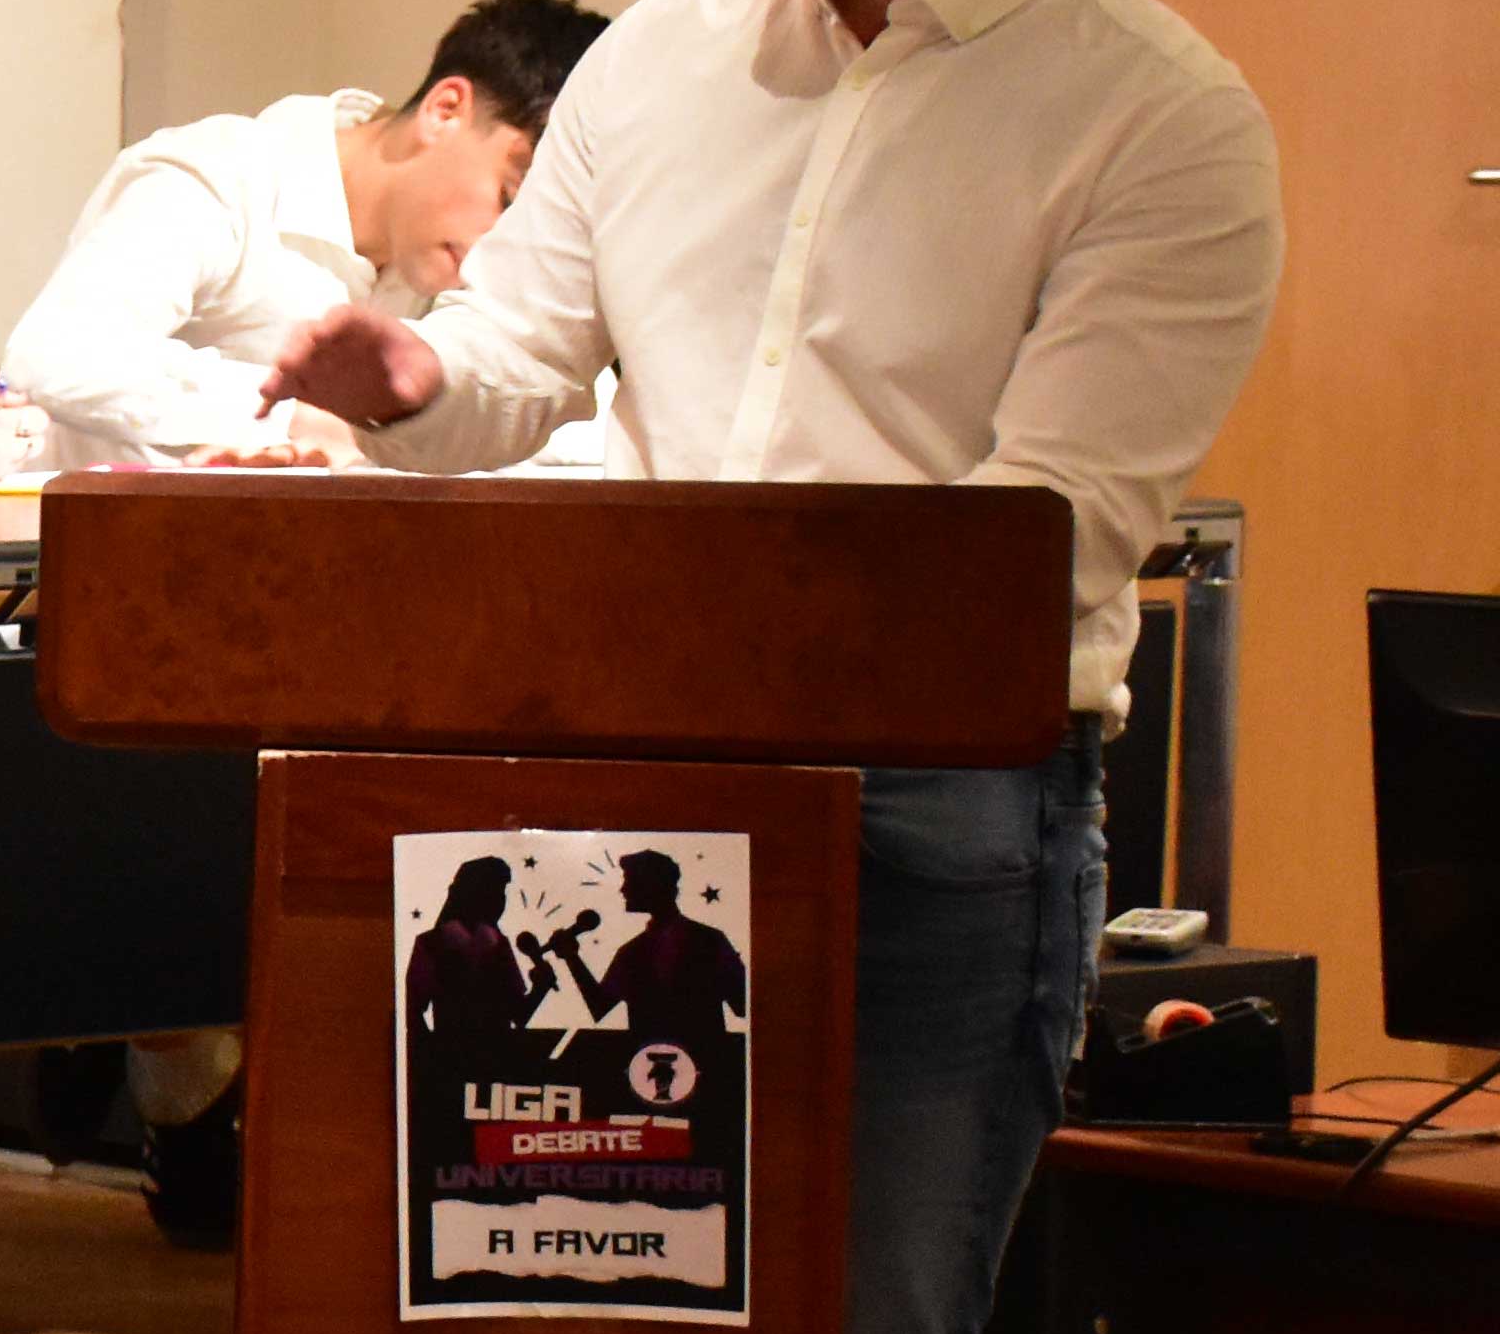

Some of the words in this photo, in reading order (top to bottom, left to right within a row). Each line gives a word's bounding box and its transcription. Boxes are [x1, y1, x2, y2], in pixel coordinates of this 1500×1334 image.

[463, 1081, 581, 1123] LIGA
[512, 1129, 643, 1155] DEBATE
[436, 1162, 725, 1194] UNIVERSITARIA
[488, 1229, 514, 1255] A
[533, 1229, 666, 1258] FAVOR
